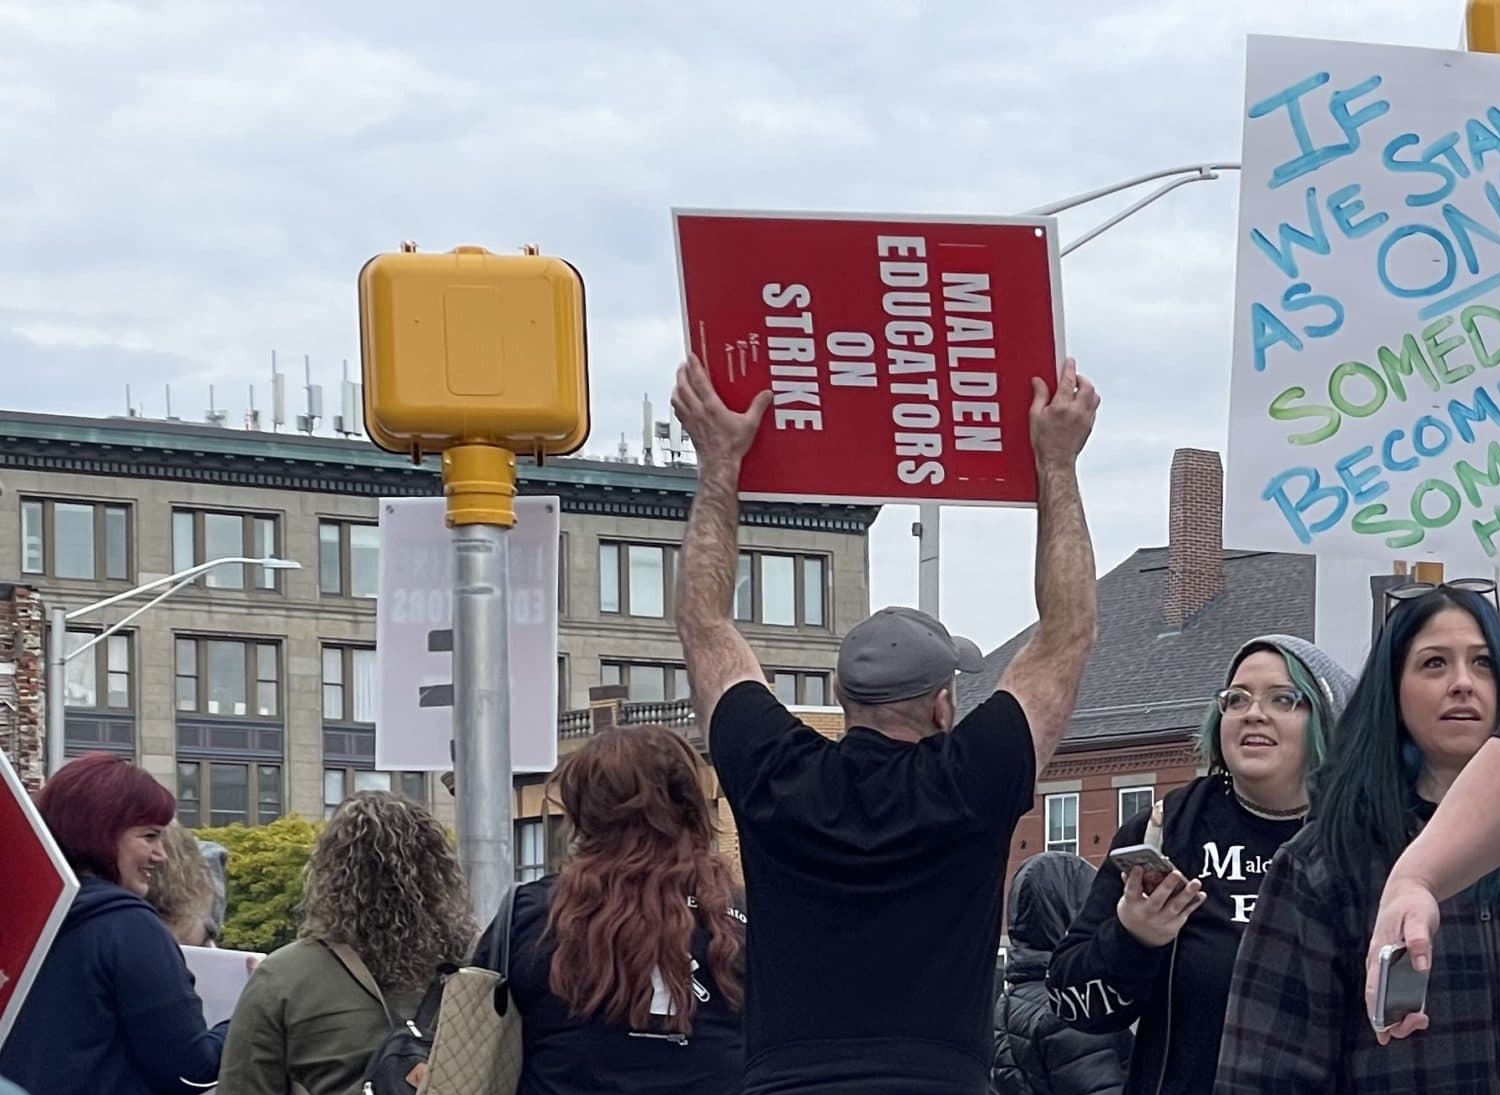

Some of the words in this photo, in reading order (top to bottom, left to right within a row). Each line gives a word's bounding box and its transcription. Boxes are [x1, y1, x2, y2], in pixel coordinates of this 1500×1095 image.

[1248, 71, 1390, 189] IF
[1250, 183, 1389, 278] WE
[762, 282, 823, 432] STRIKE
[826, 331, 878, 388] ON
[876, 235, 945, 486] EDUCATORS
[941, 272, 1003, 452] MALDEN
[1251, 283, 1344, 371] AS
